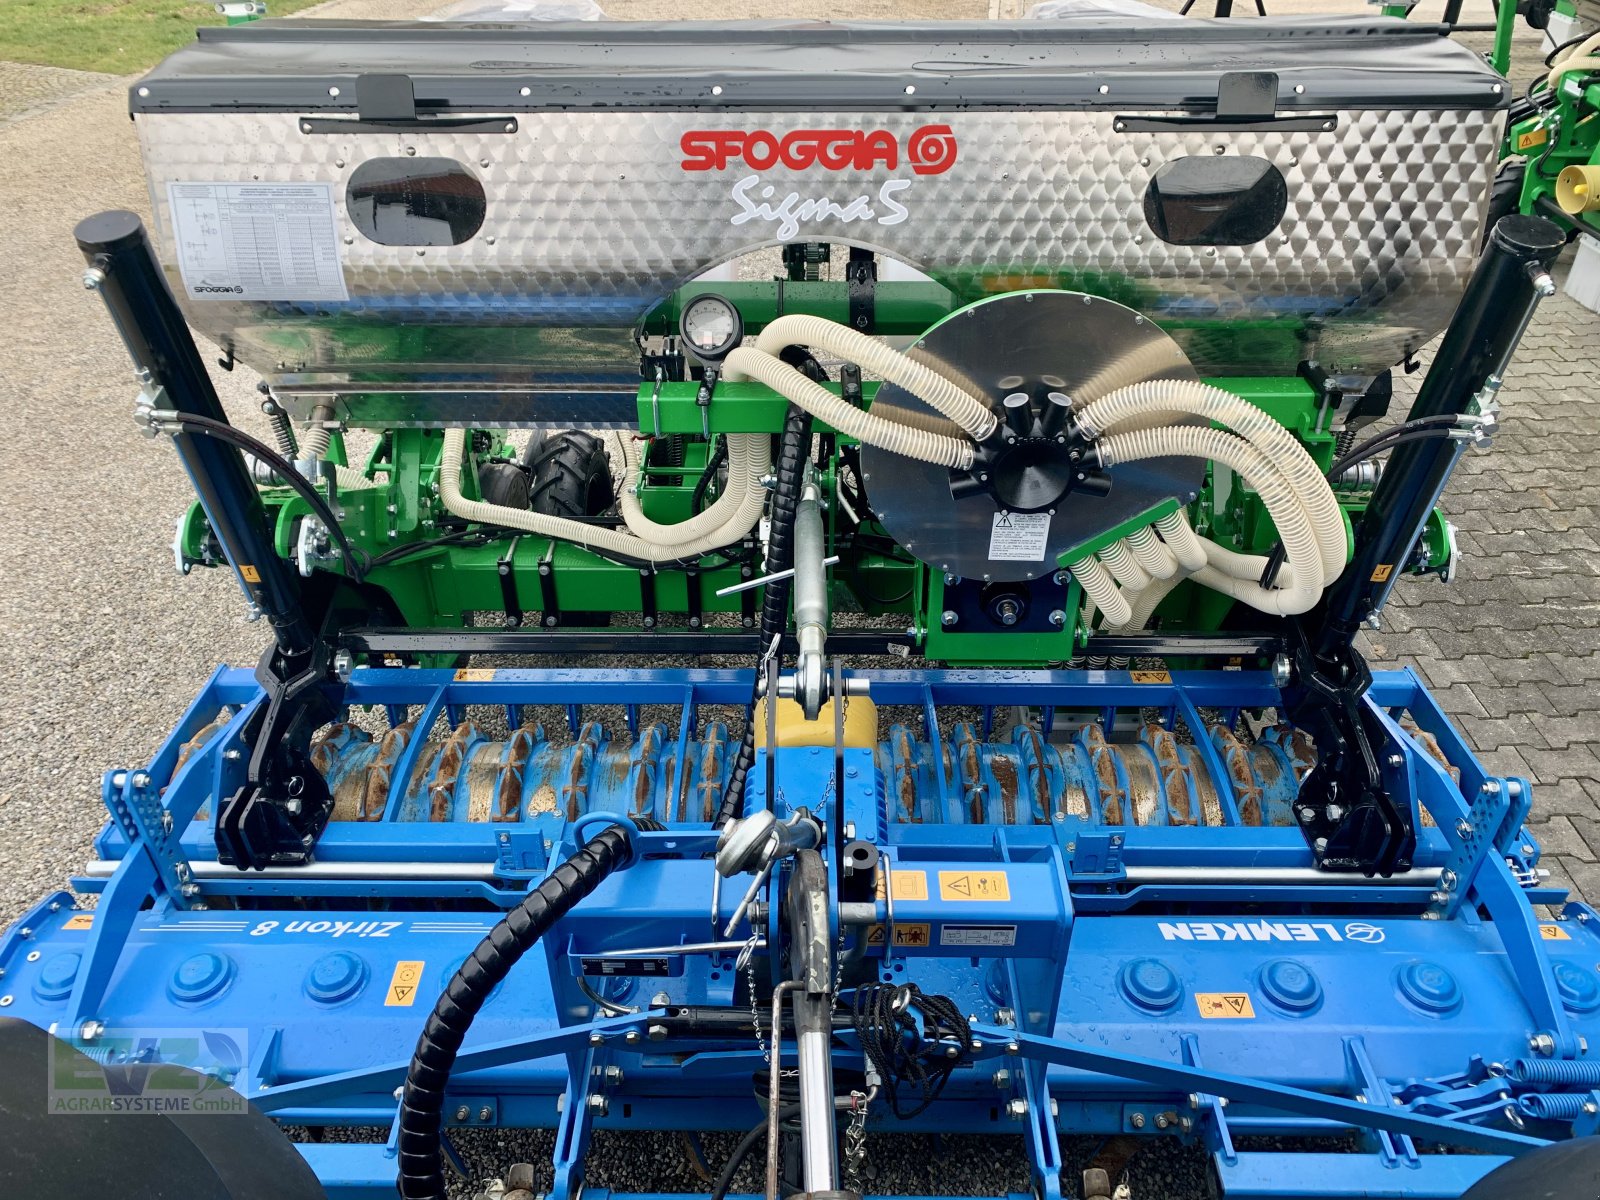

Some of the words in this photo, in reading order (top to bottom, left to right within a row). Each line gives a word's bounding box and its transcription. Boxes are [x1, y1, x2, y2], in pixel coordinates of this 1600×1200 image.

[680, 129, 898, 171] SFOGGIA
[730, 174, 875, 241] Sigma
[194, 286, 234, 294] SFOGGIA
[250, 920, 280, 936] 8
[283, 920, 403, 938] Zirkon
[1157, 919, 1344, 941] LEMKEN
